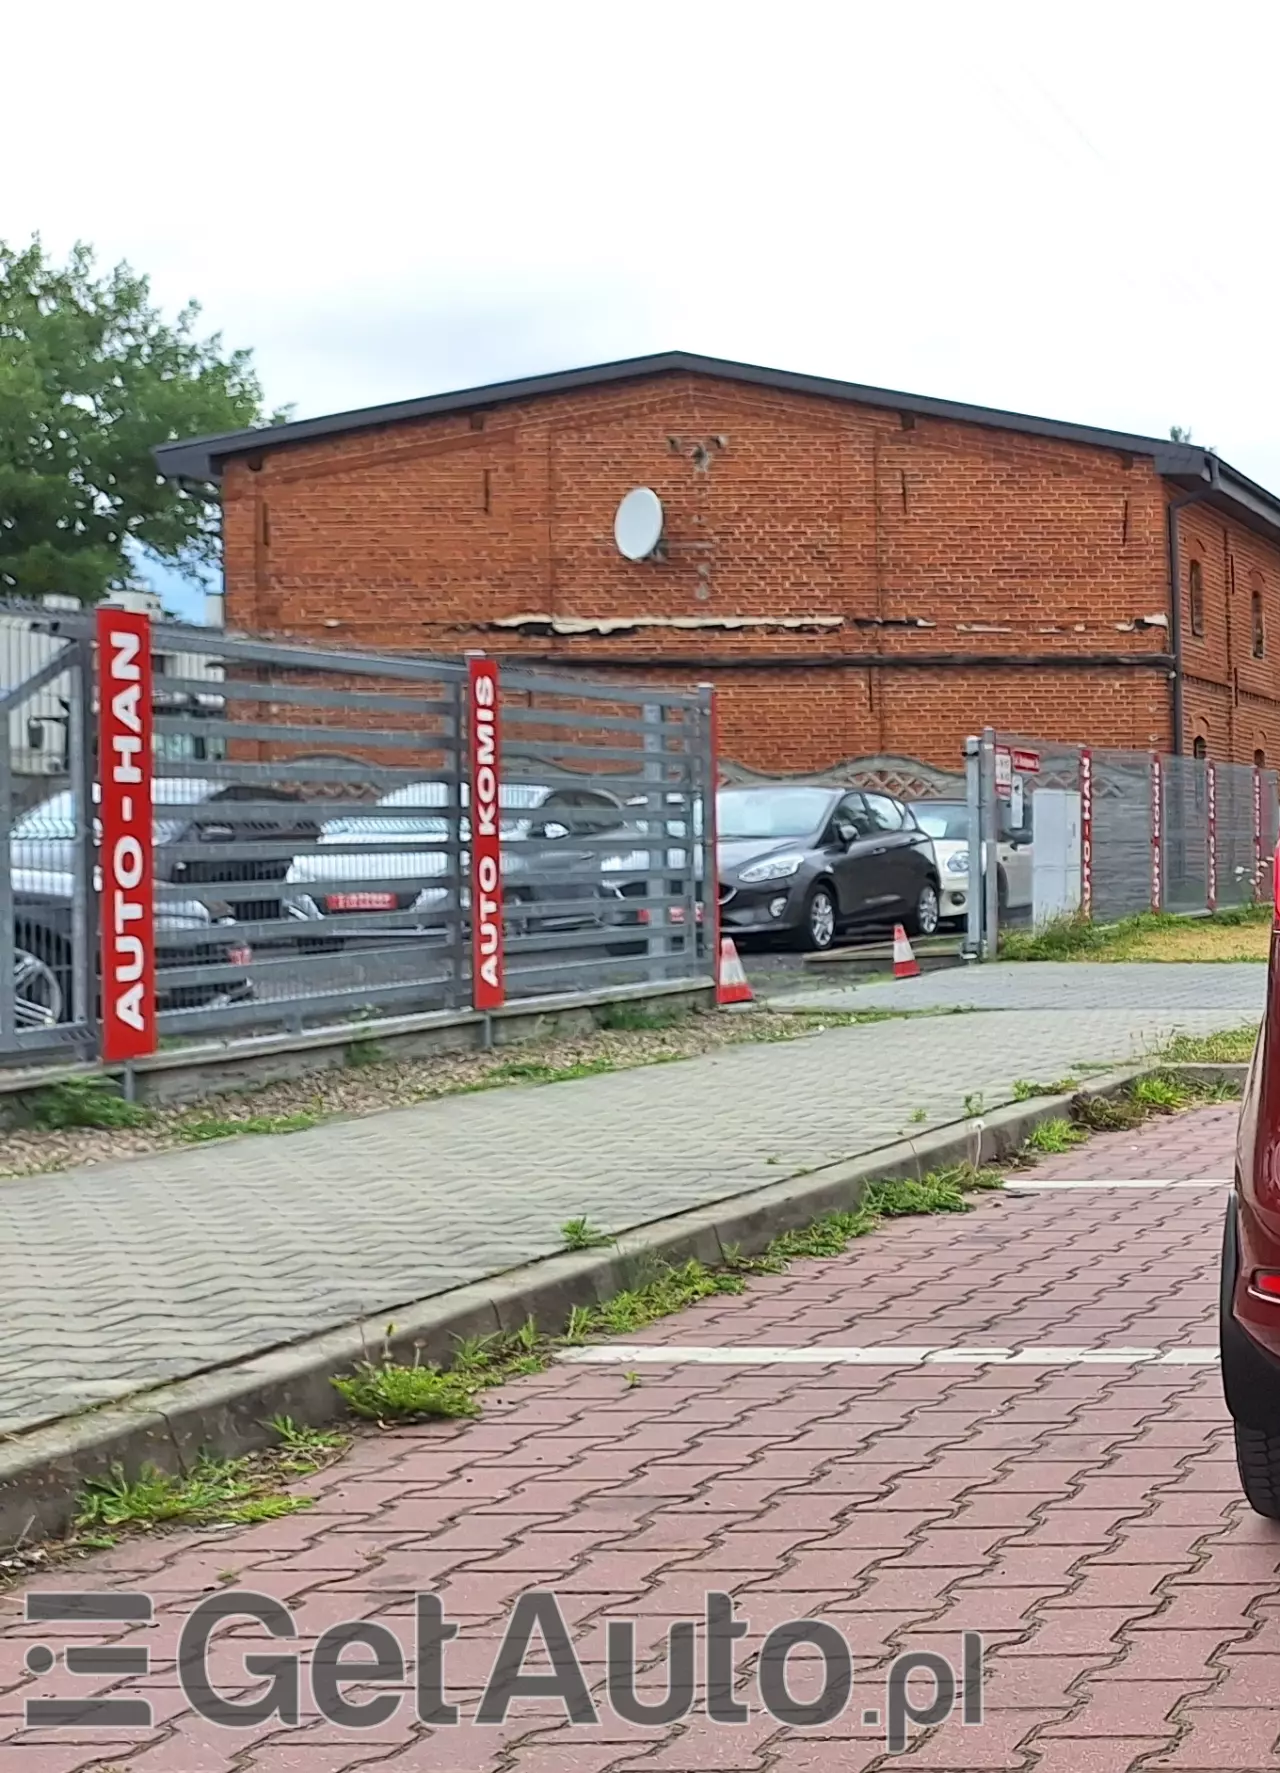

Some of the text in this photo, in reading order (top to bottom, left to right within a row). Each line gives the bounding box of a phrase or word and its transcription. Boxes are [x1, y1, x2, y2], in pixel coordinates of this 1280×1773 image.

[109, 630, 142, 784] HAN
[475, 675, 499, 988] AUTO KOMIS
[1082, 757, 1091, 820] HAN
[114, 835, 145, 1032] AUTO
[1082, 839, 1091, 920] AUTO
